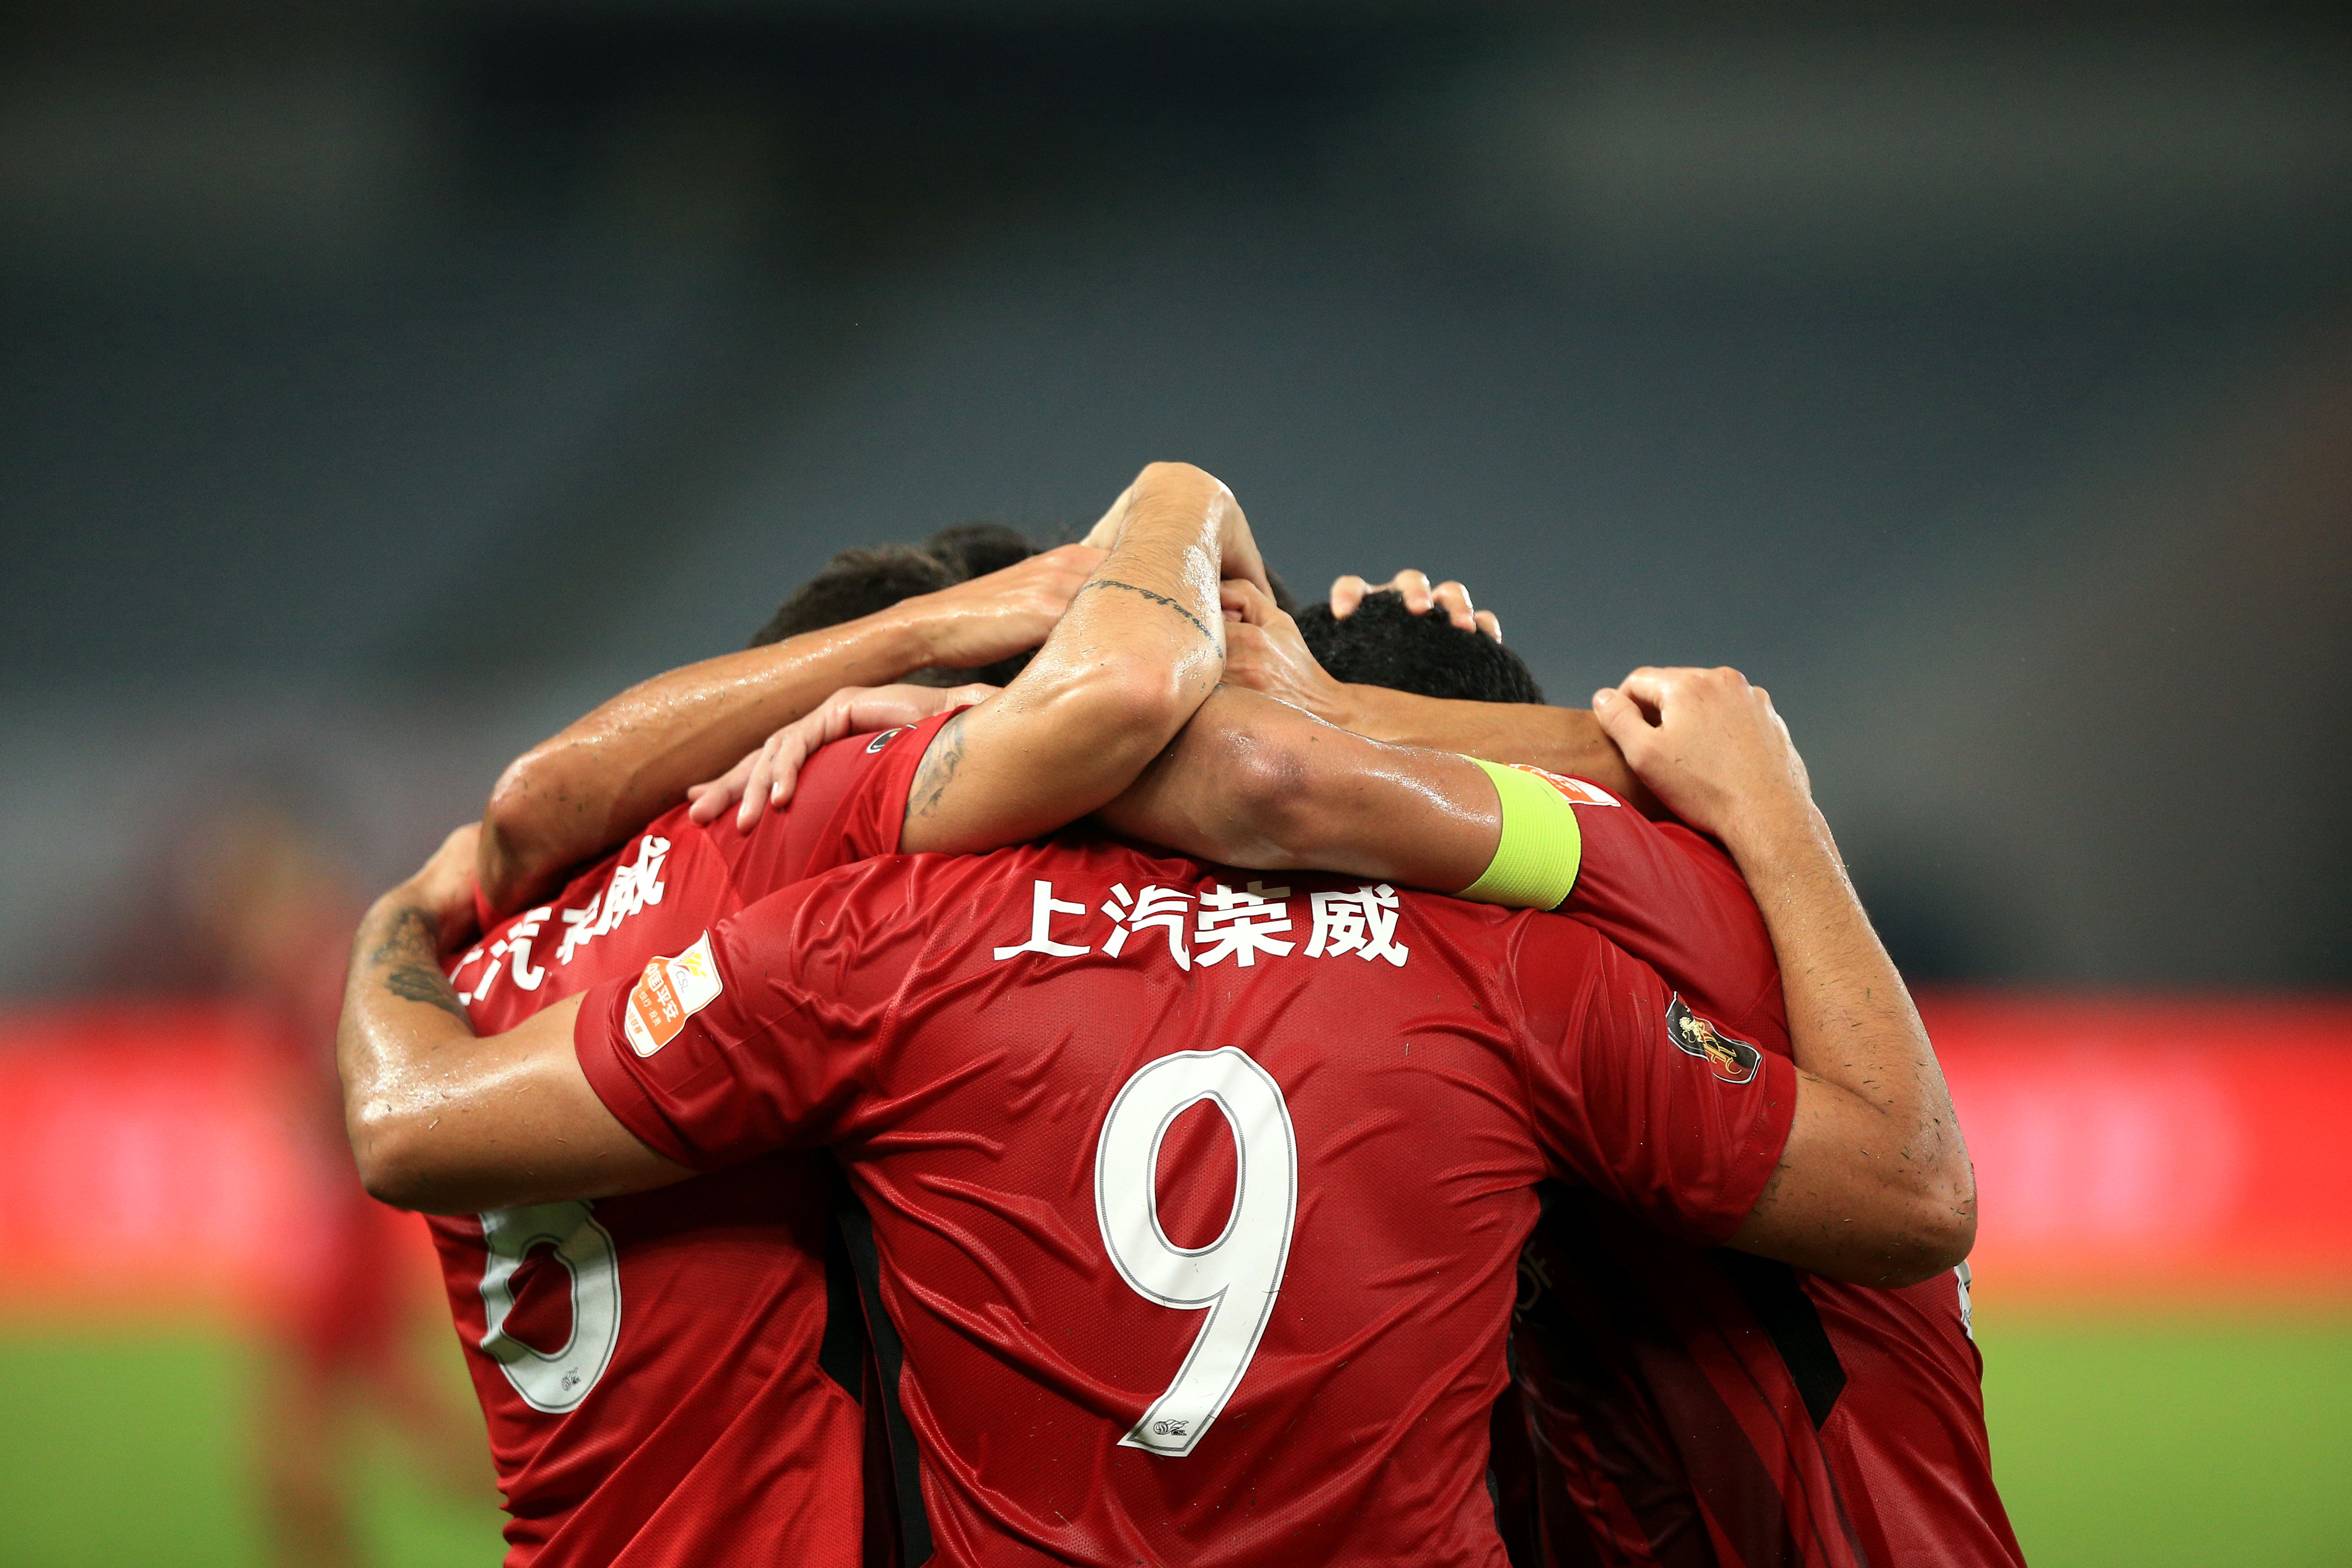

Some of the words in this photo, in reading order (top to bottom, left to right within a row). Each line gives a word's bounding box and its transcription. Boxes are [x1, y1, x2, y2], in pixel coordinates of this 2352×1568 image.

[994, 880, 1409, 972] 上汽荣威
[645, 963, 679, 1022] 中国平安
[676, 970, 688, 993] CSL
[1094, 1045, 1298, 1457] 9
